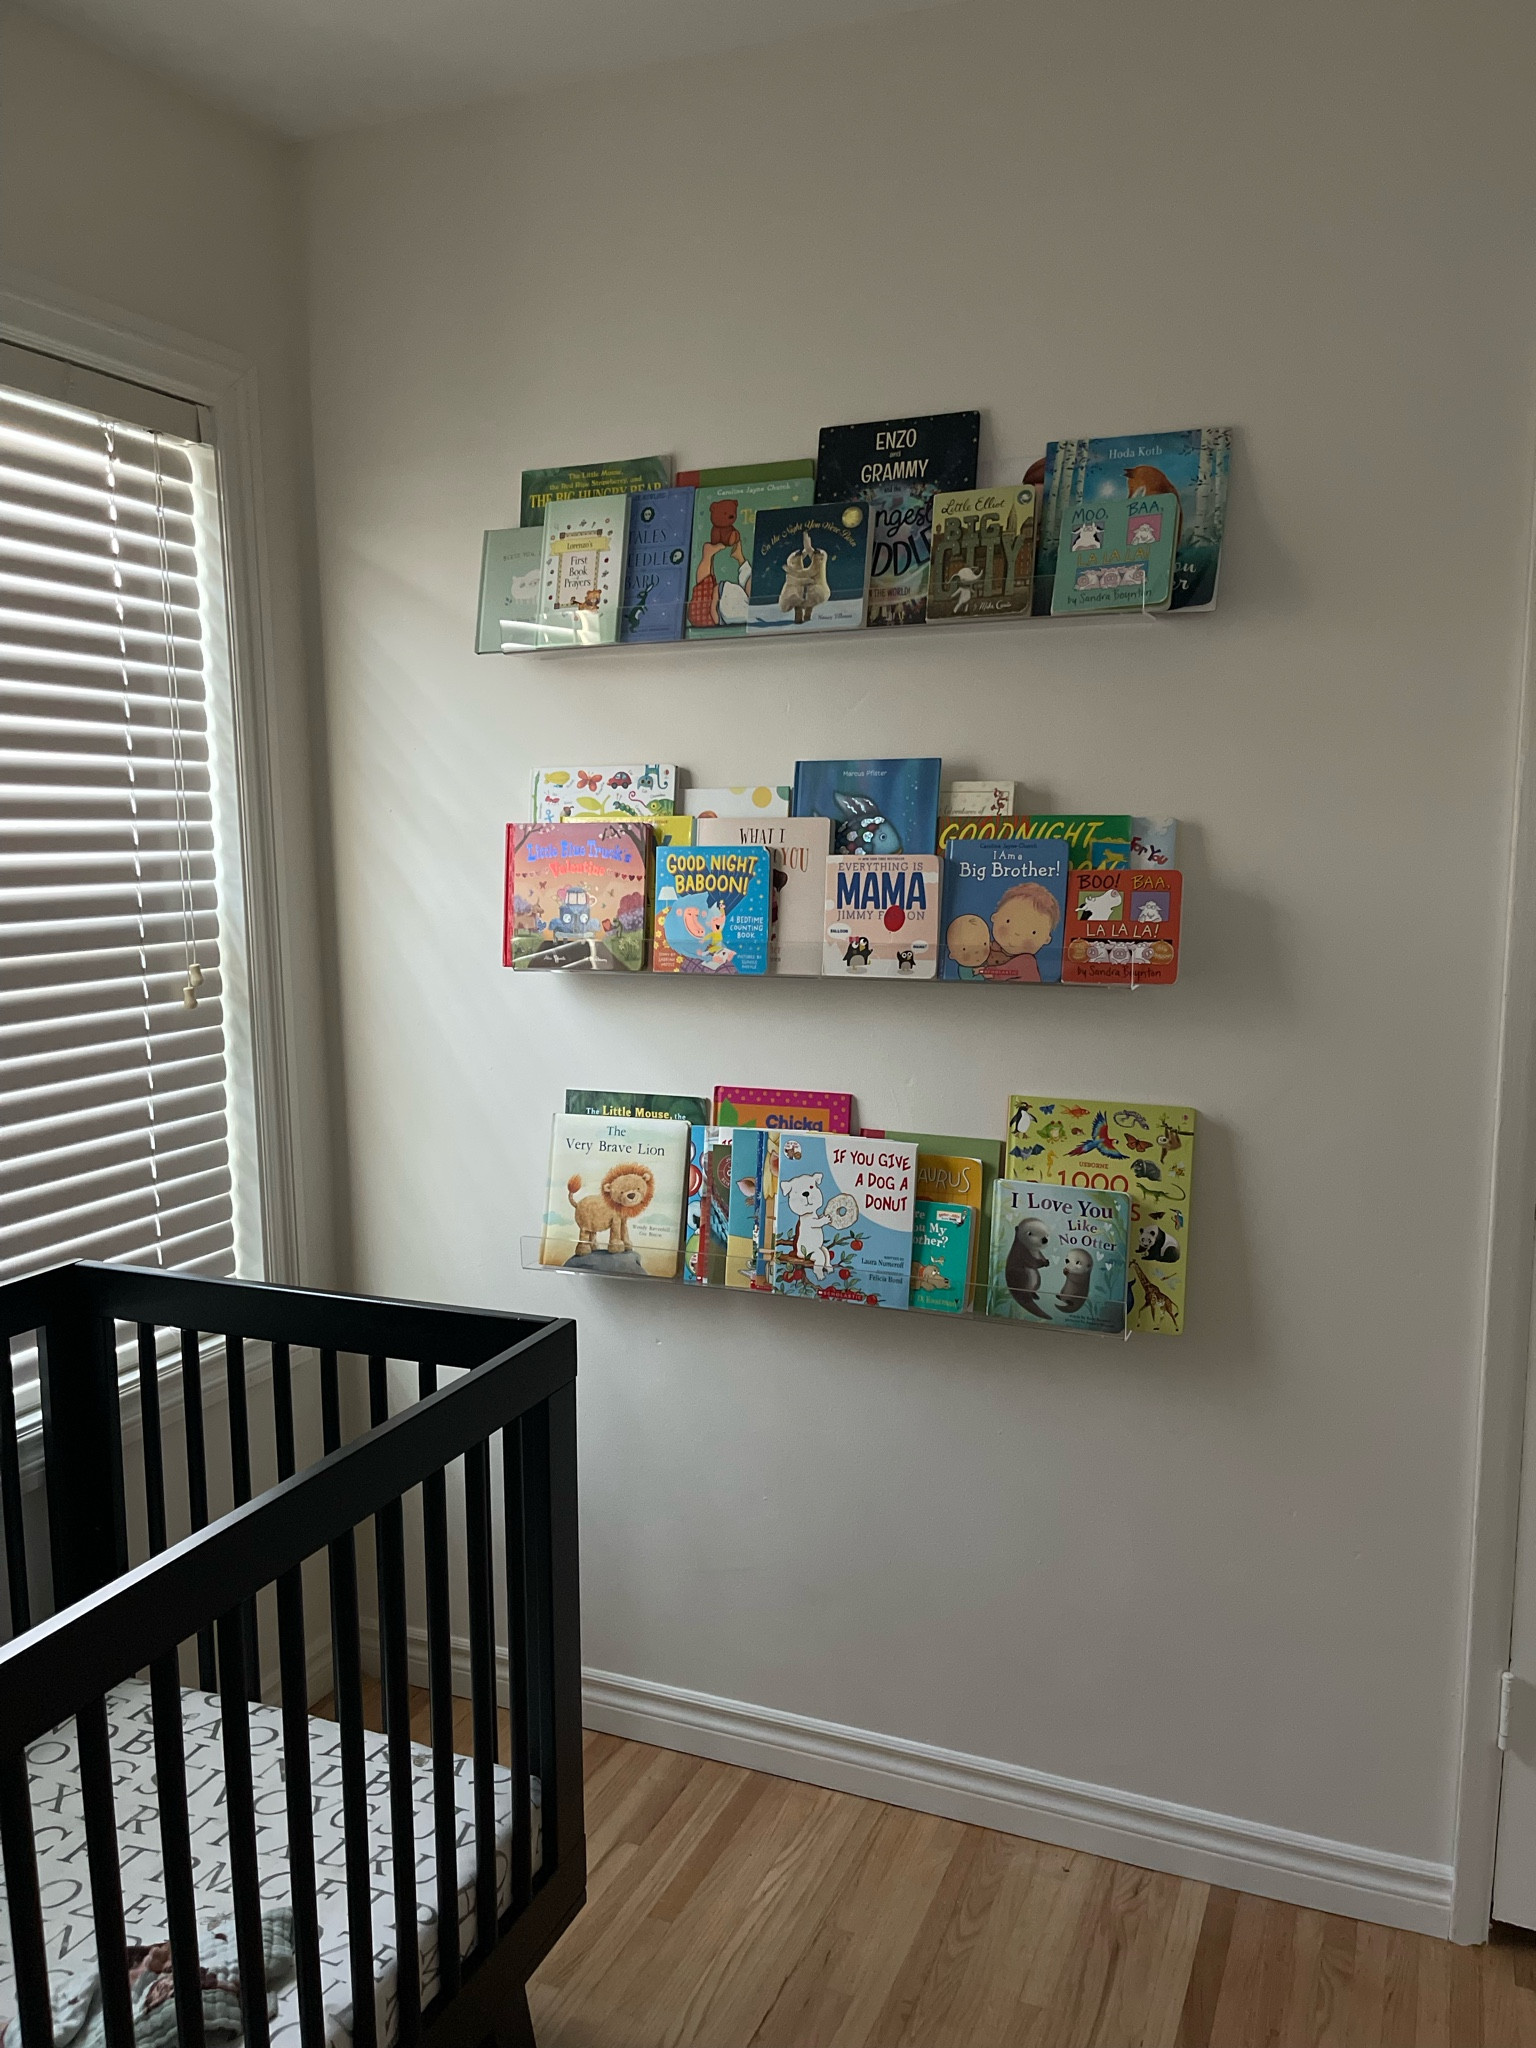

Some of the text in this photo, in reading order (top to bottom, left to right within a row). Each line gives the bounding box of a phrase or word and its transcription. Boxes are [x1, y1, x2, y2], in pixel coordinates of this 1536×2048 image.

[876, 428, 917, 451] ENZO
[1109, 445, 1163, 459] Hoda Kotb
[861, 459, 929, 484] GRAMMY
[941, 496, 1006, 515] Little Elliot
[1071, 500, 1164, 524] MOO, BAA,
[944, 512, 1001, 541] BIG
[566, 540, 593, 550] Lorenzo's
[571, 555, 588, 566] First
[569, 565, 588, 577] Book
[564, 578, 592, 590] Prayers
[1080, 591, 1111, 605] Sandra
[866, 769, 887, 777] Pfister
[739, 827, 787, 845] WHAT I
[938, 821, 1104, 850] GOODNIGHT
[526, 839, 632, 864] Little Blue Truck's
[781, 846, 810, 873] YOU
[993, 850, 997, 860] I
[998, 849, 1016, 860] Am
[548, 860, 606, 880] Valentine
[666, 853, 706, 874] GOOD
[710, 855, 759, 877] NIGHT,
[838, 861, 924, 872] EVERYTHING IS
[959, 861, 987, 881] Big
[990, 860, 1060, 878] Brother!
[674, 874, 751, 896] BABOON!
[1077, 873, 1171, 890] BOO! BAA,
[836, 872, 927, 910] MAMA
[729, 916, 764, 925] A BEDTIME
[836, 910, 925, 922] JIMMY FON
[729, 923, 764, 932] COUNTING
[736, 931, 756, 939] BOOK
[1086, 922, 1160, 939] LA LA LA!
[1077, 965, 1161, 979] by Sandra Boynton
[586, 1105, 686, 1121] The Little Mouse, the
[606, 1125, 627, 1137] The
[765, 1114, 823, 1133] Chicka
[565, 1137, 666, 1157] Very Brave Lion
[833, 1148, 911, 1171] IF YOU GIVE
[855, 1173, 909, 1191] A DOG A
[1057, 1170, 1129, 1192] 1000
[865, 1194, 908, 1212] DONUT
[1010, 1192, 1020, 1209] I
[1027, 1192, 1073, 1215] Love
[1078, 1200, 1114, 1219] You
[914, 1210, 926, 1219] re
[929, 1222, 948, 1237] My
[1068, 1219, 1098, 1234] Like
[912, 1234, 949, 1249] other?
[1058, 1233, 1117, 1252] No Otter
[861, 1257, 905, 1269] Laura Numeroff
[869, 1273, 887, 1283] Felicia
[823, 1290, 863, 1301] SCHOLASTIC
